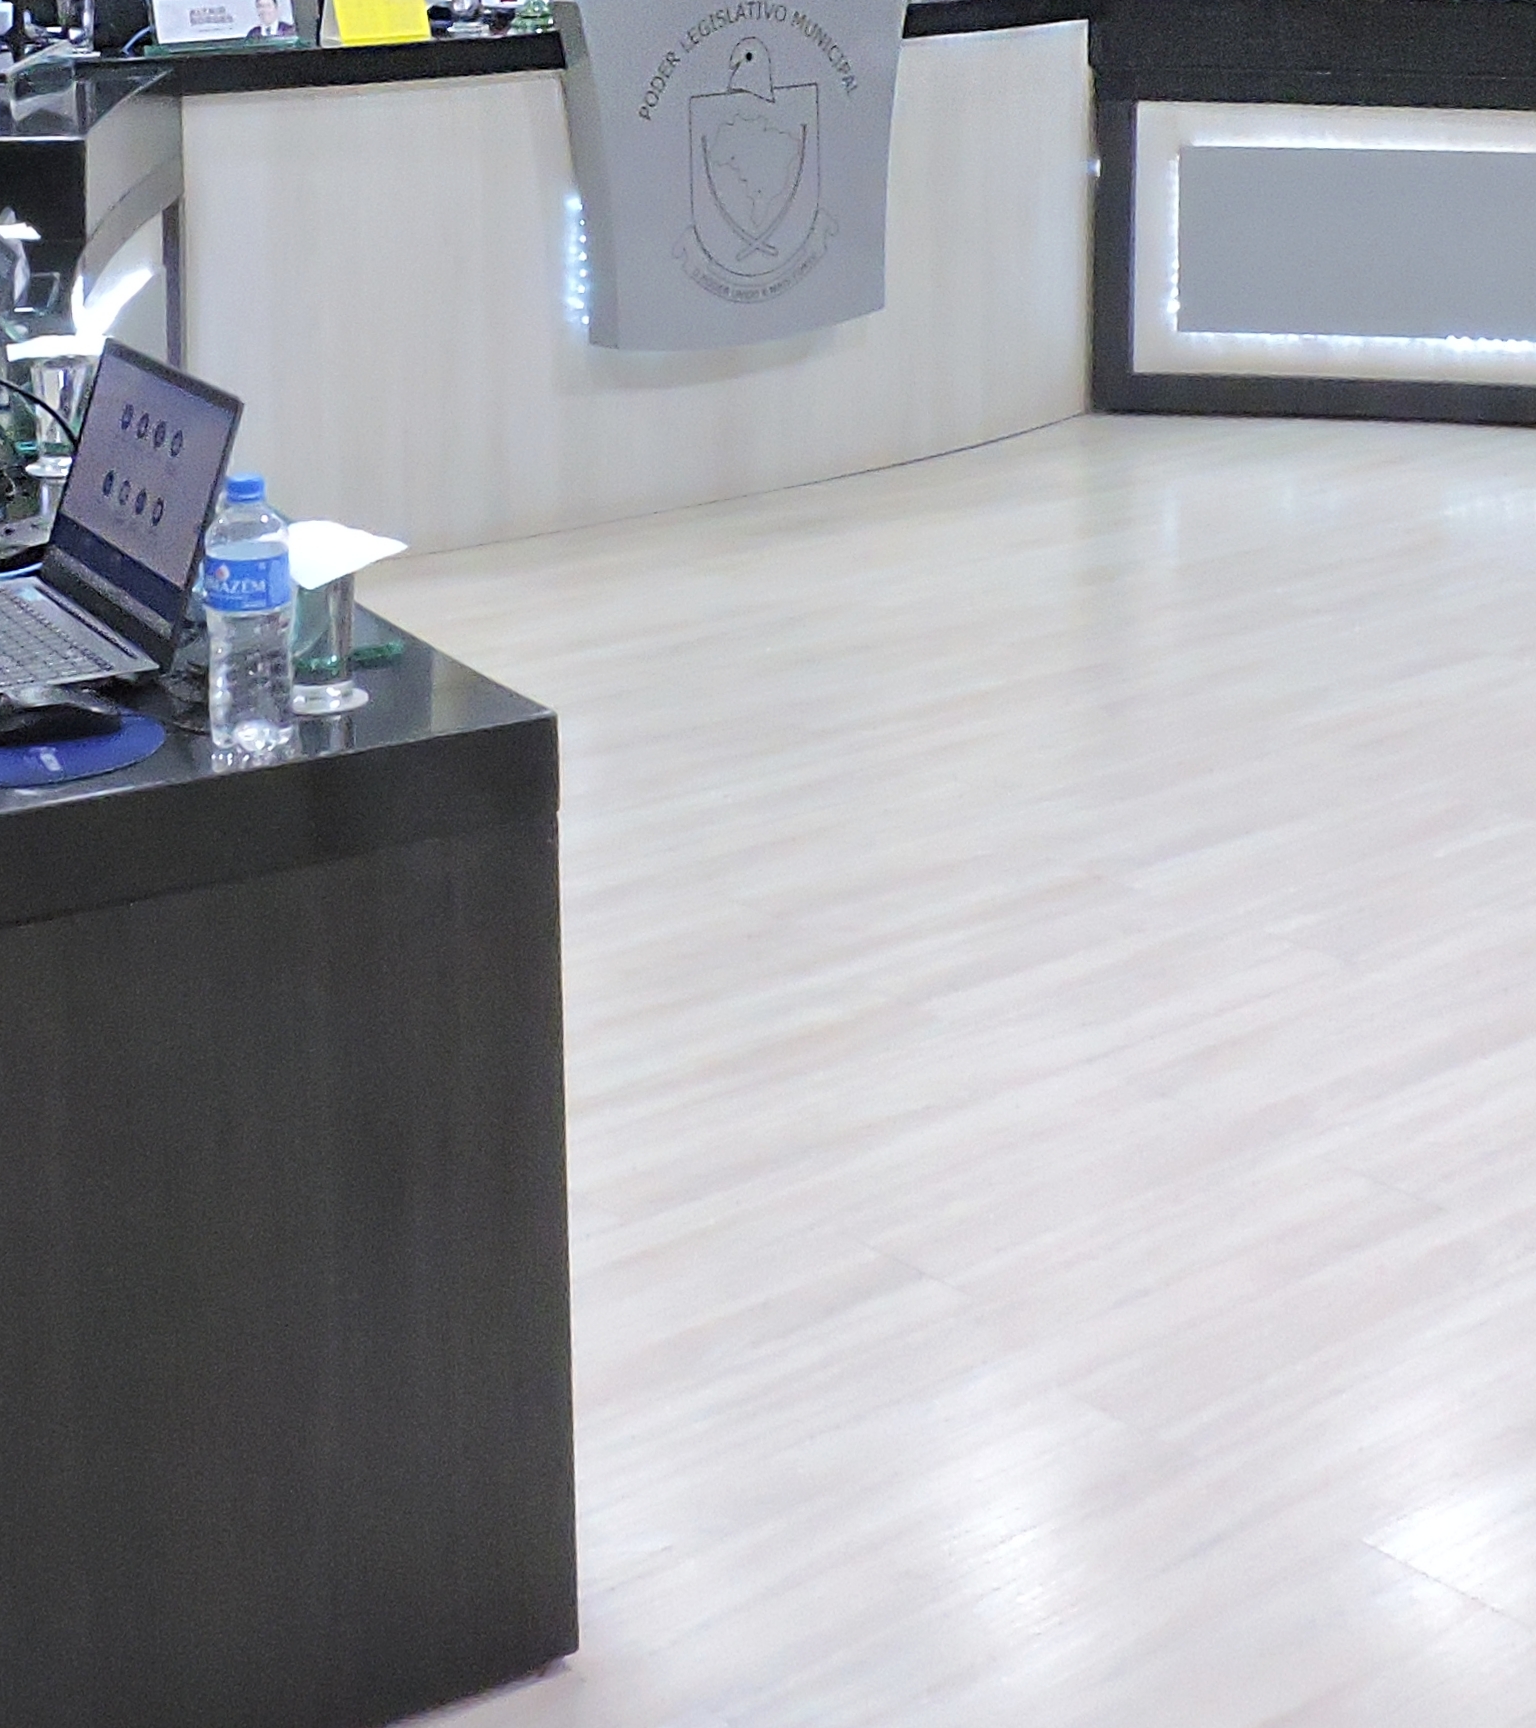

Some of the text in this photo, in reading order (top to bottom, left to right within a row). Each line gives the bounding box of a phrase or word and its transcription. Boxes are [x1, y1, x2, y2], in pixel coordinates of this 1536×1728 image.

[638, 0, 859, 121] PODER LEGISLATIVO MUNICIPAL
